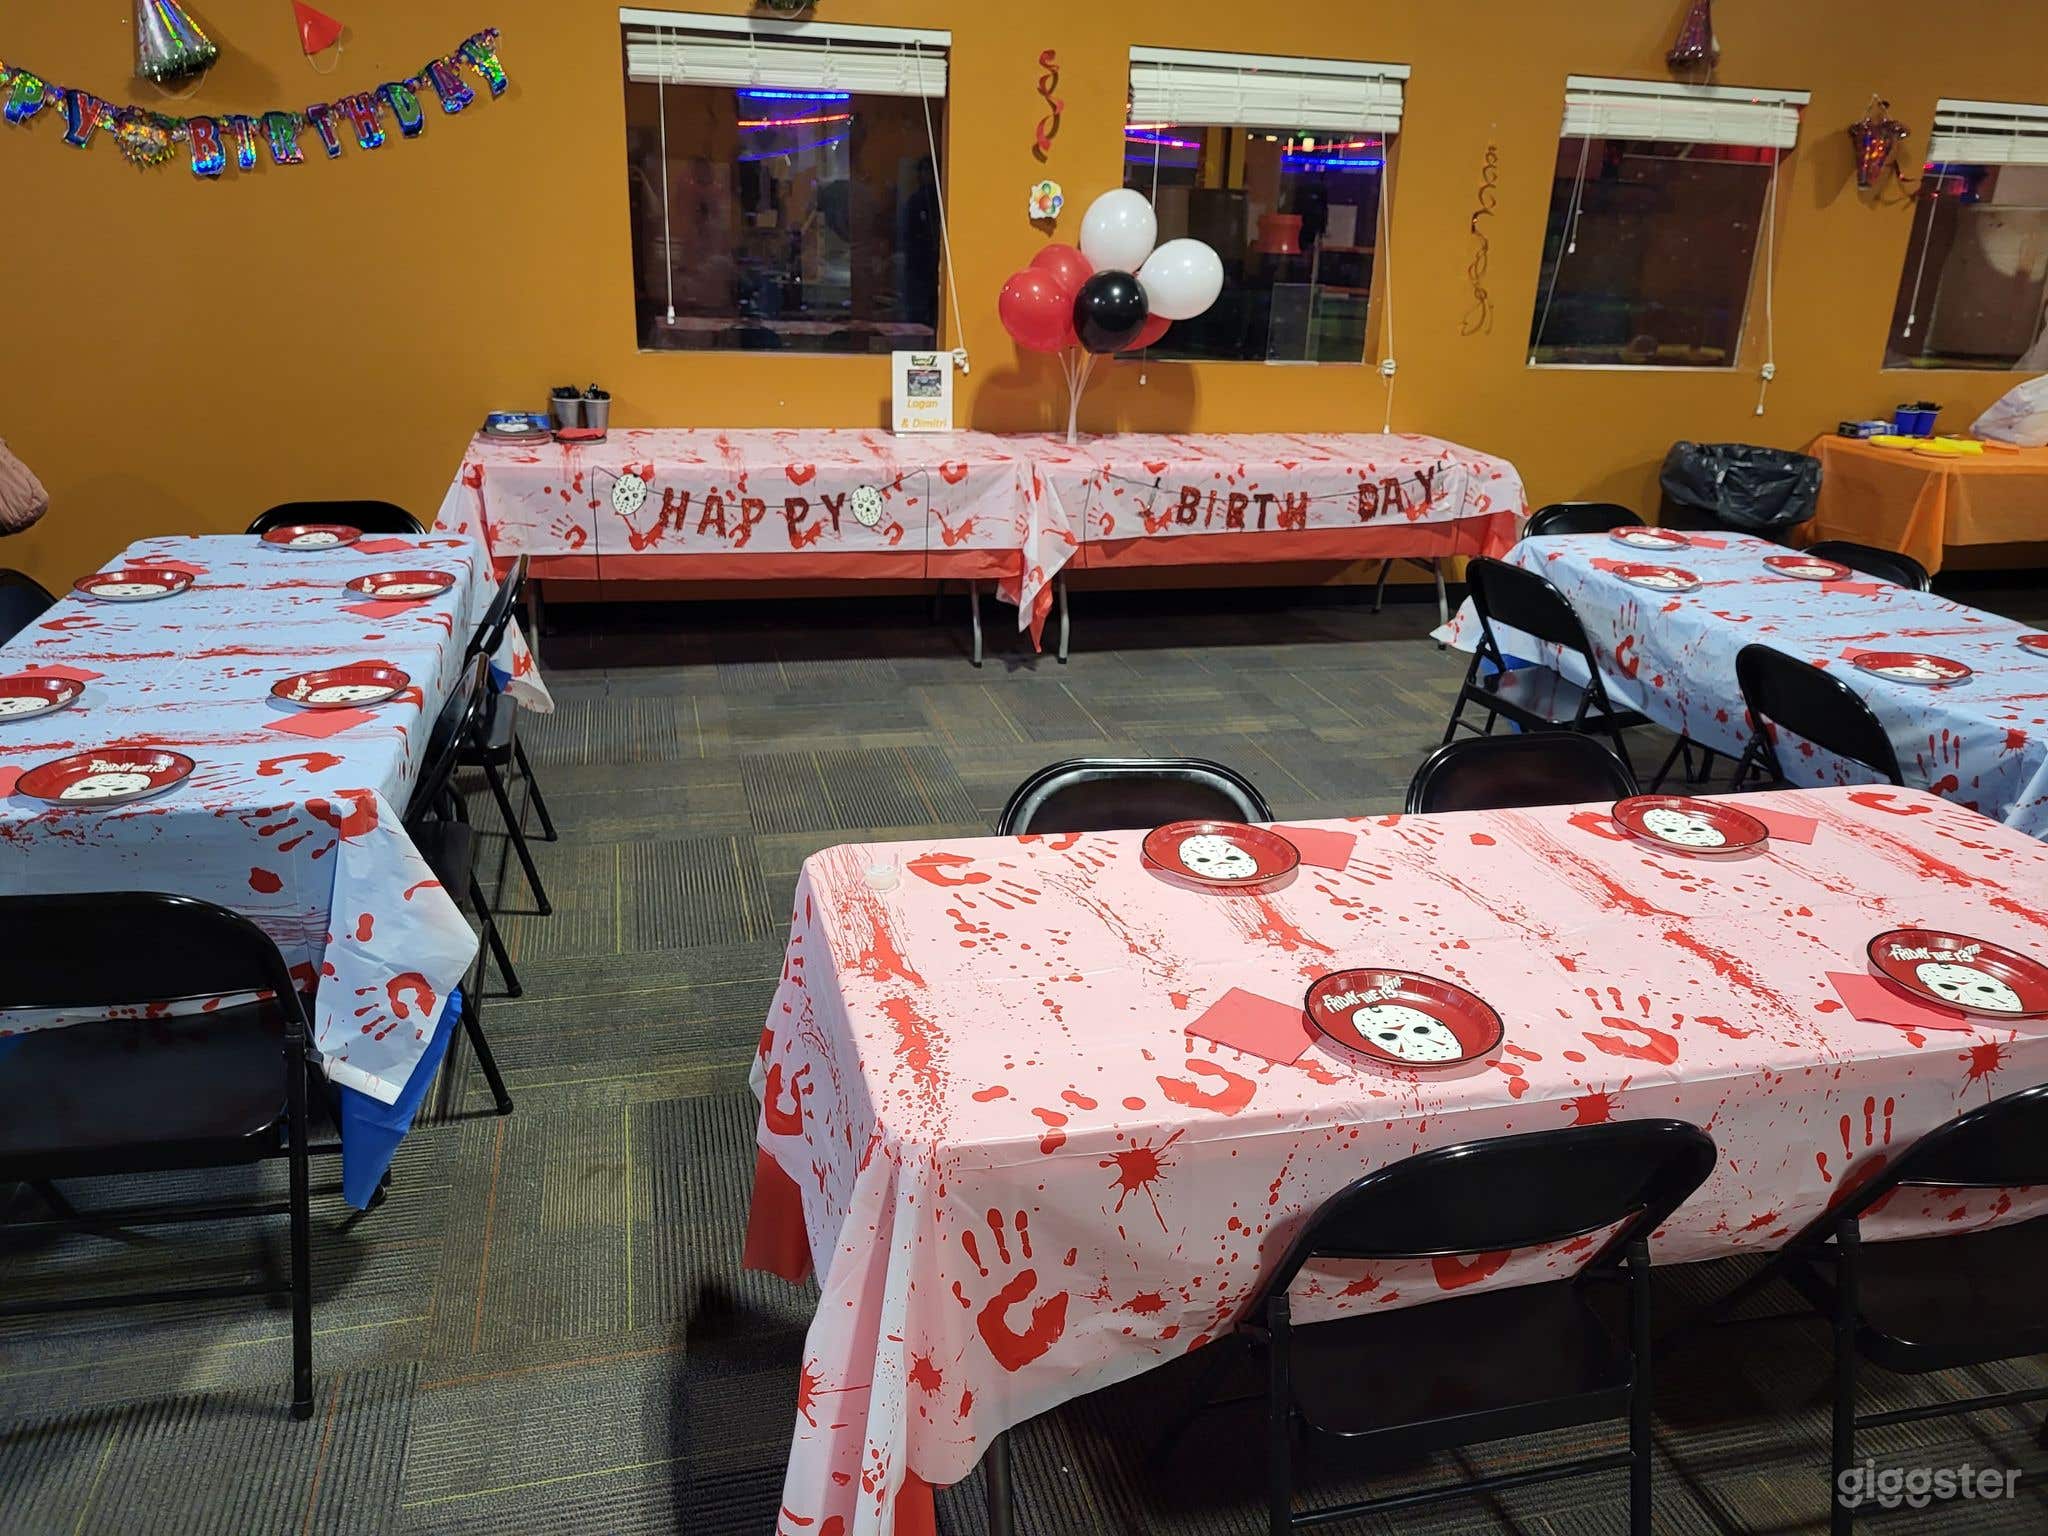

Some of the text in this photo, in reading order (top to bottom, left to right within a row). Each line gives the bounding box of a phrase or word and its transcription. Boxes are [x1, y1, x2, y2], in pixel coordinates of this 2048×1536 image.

[187, 30, 508, 176] BIRTHDAY
[660, 487, 846, 543] HAPPY
[1175, 466, 1435, 530] BIRTH DAY
[1888, 943, 1931, 961] FRIDAY
[1321, 989, 1361, 1014] FRIDAY
[1356, 988, 1382, 1004] THE
